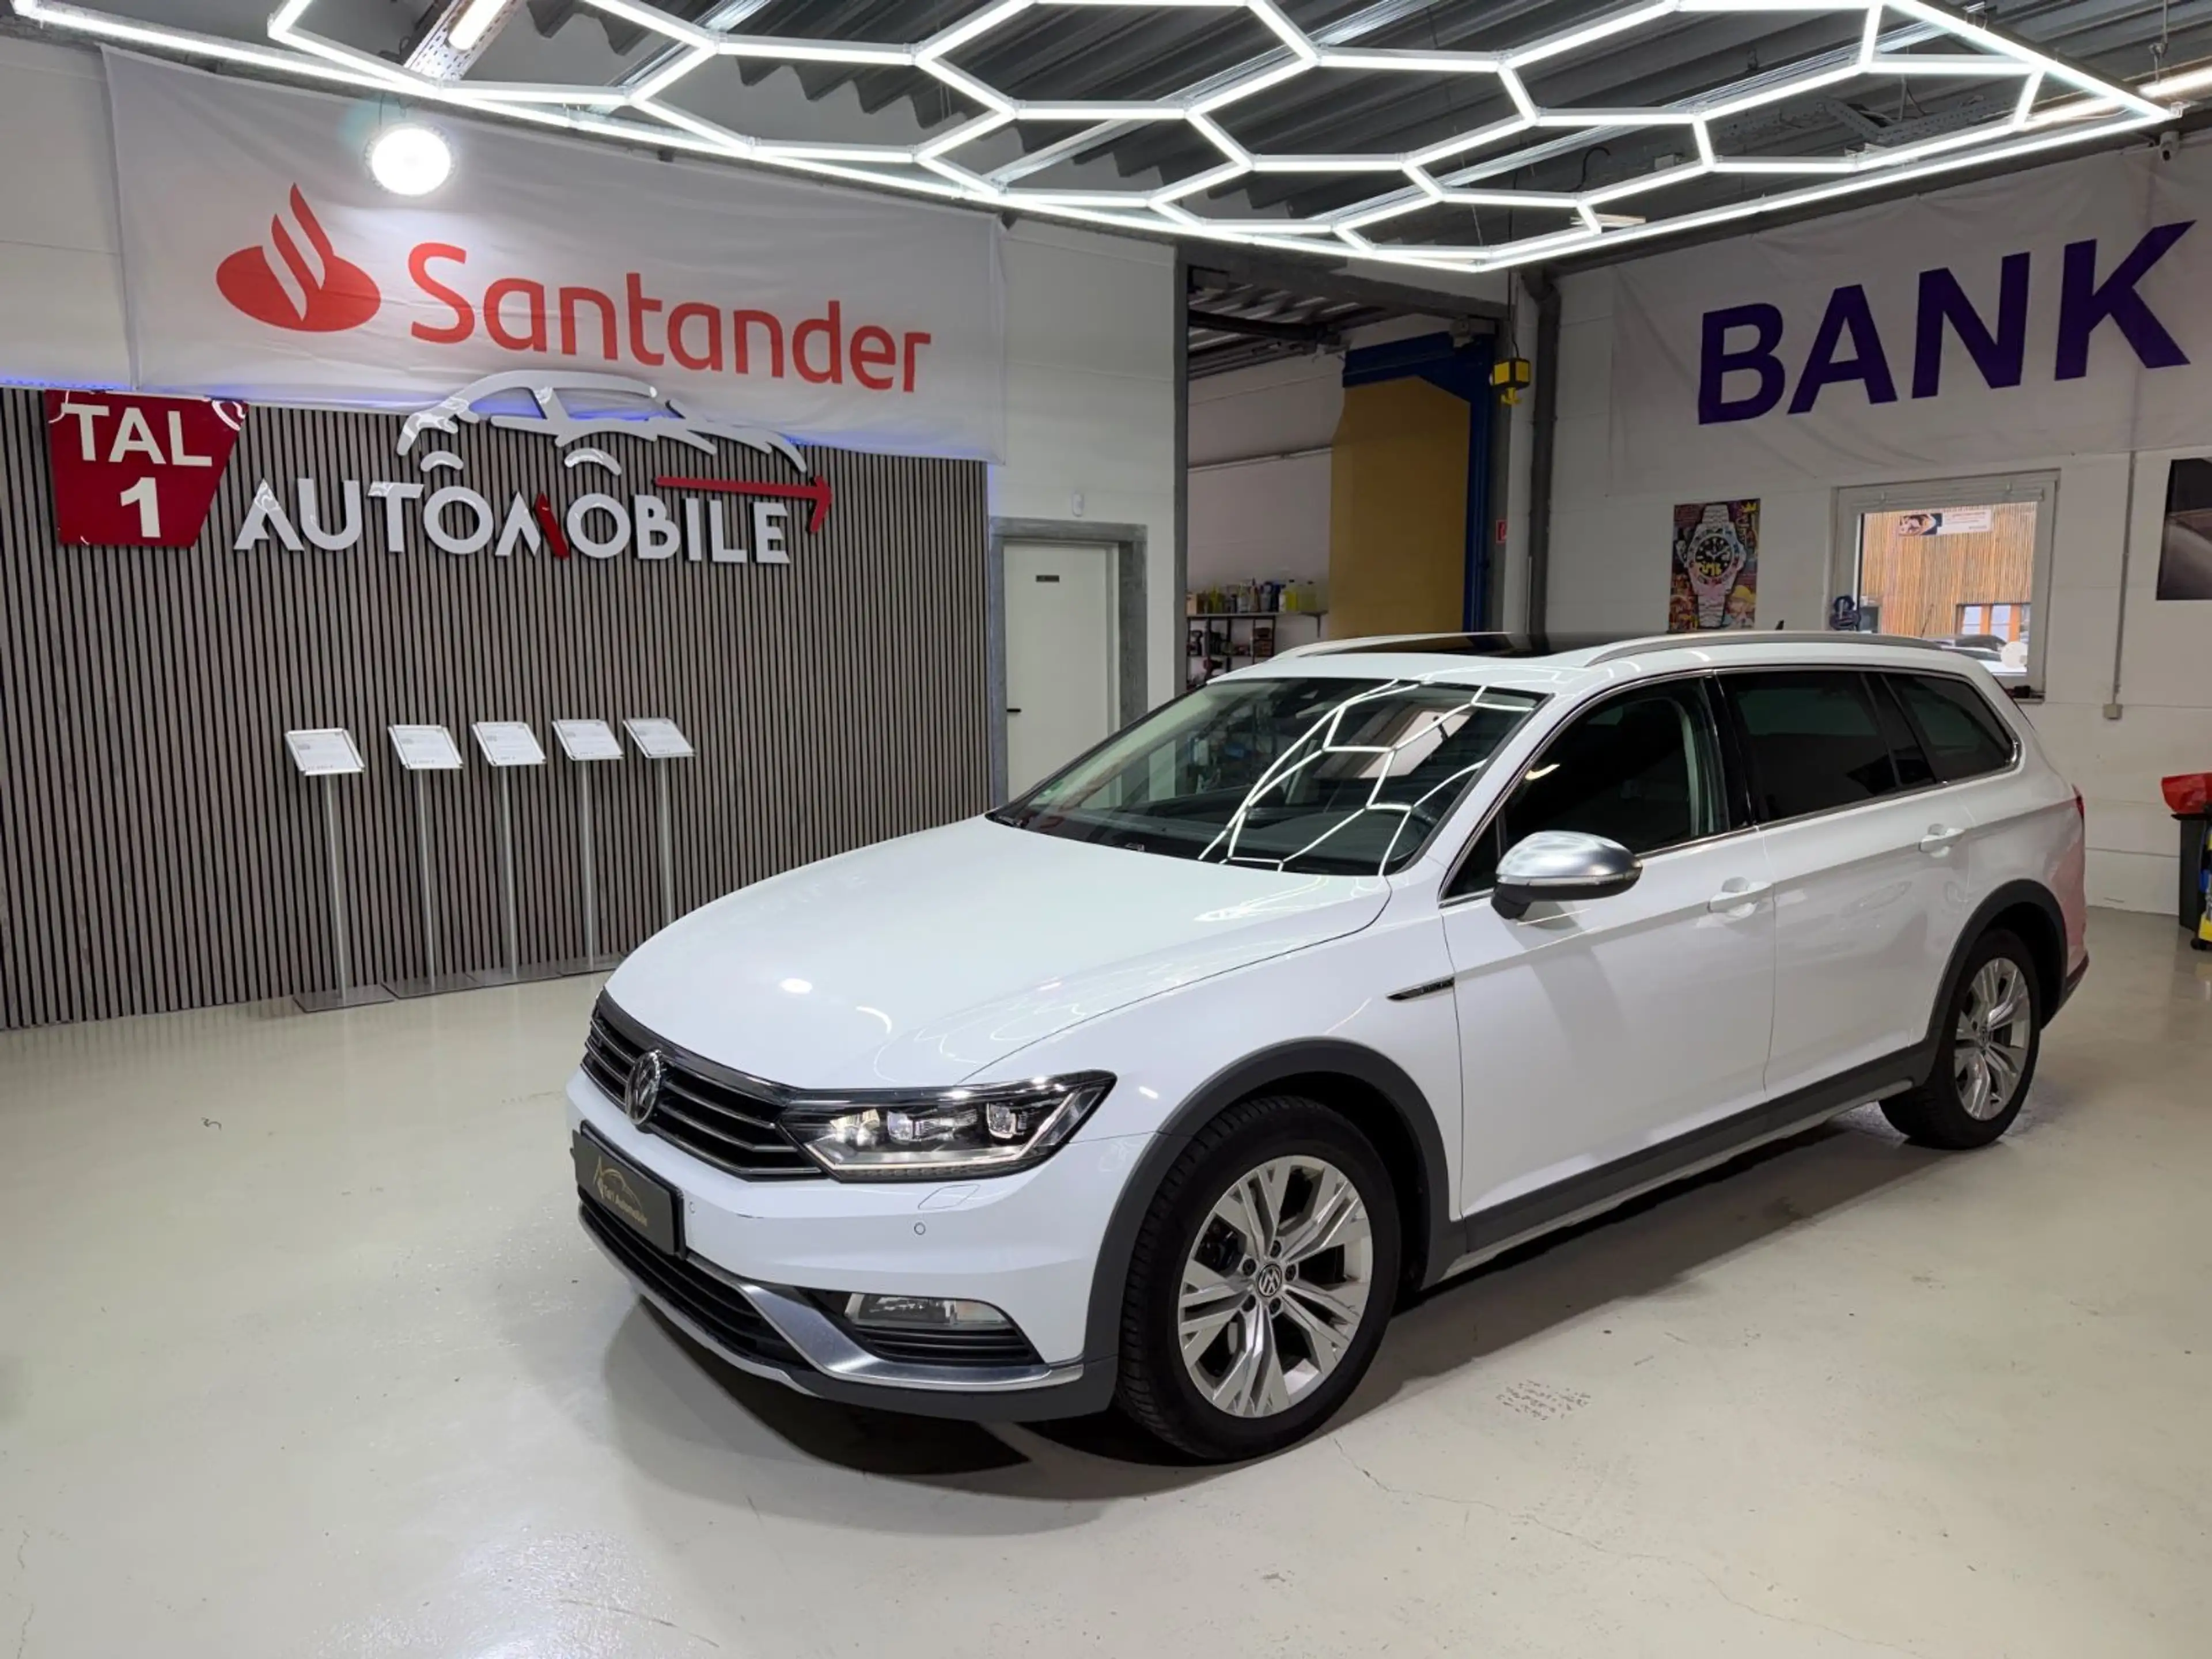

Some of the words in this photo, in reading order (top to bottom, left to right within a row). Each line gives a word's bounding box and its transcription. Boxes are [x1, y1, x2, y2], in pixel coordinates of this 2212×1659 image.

[407, 241, 932, 392] Santander
[1698, 219, 2197, 425] BANK
[61, 403, 213, 467] TAL
[120, 476, 161, 538] 1
[233, 477, 791, 565] AUTOMOBILE
